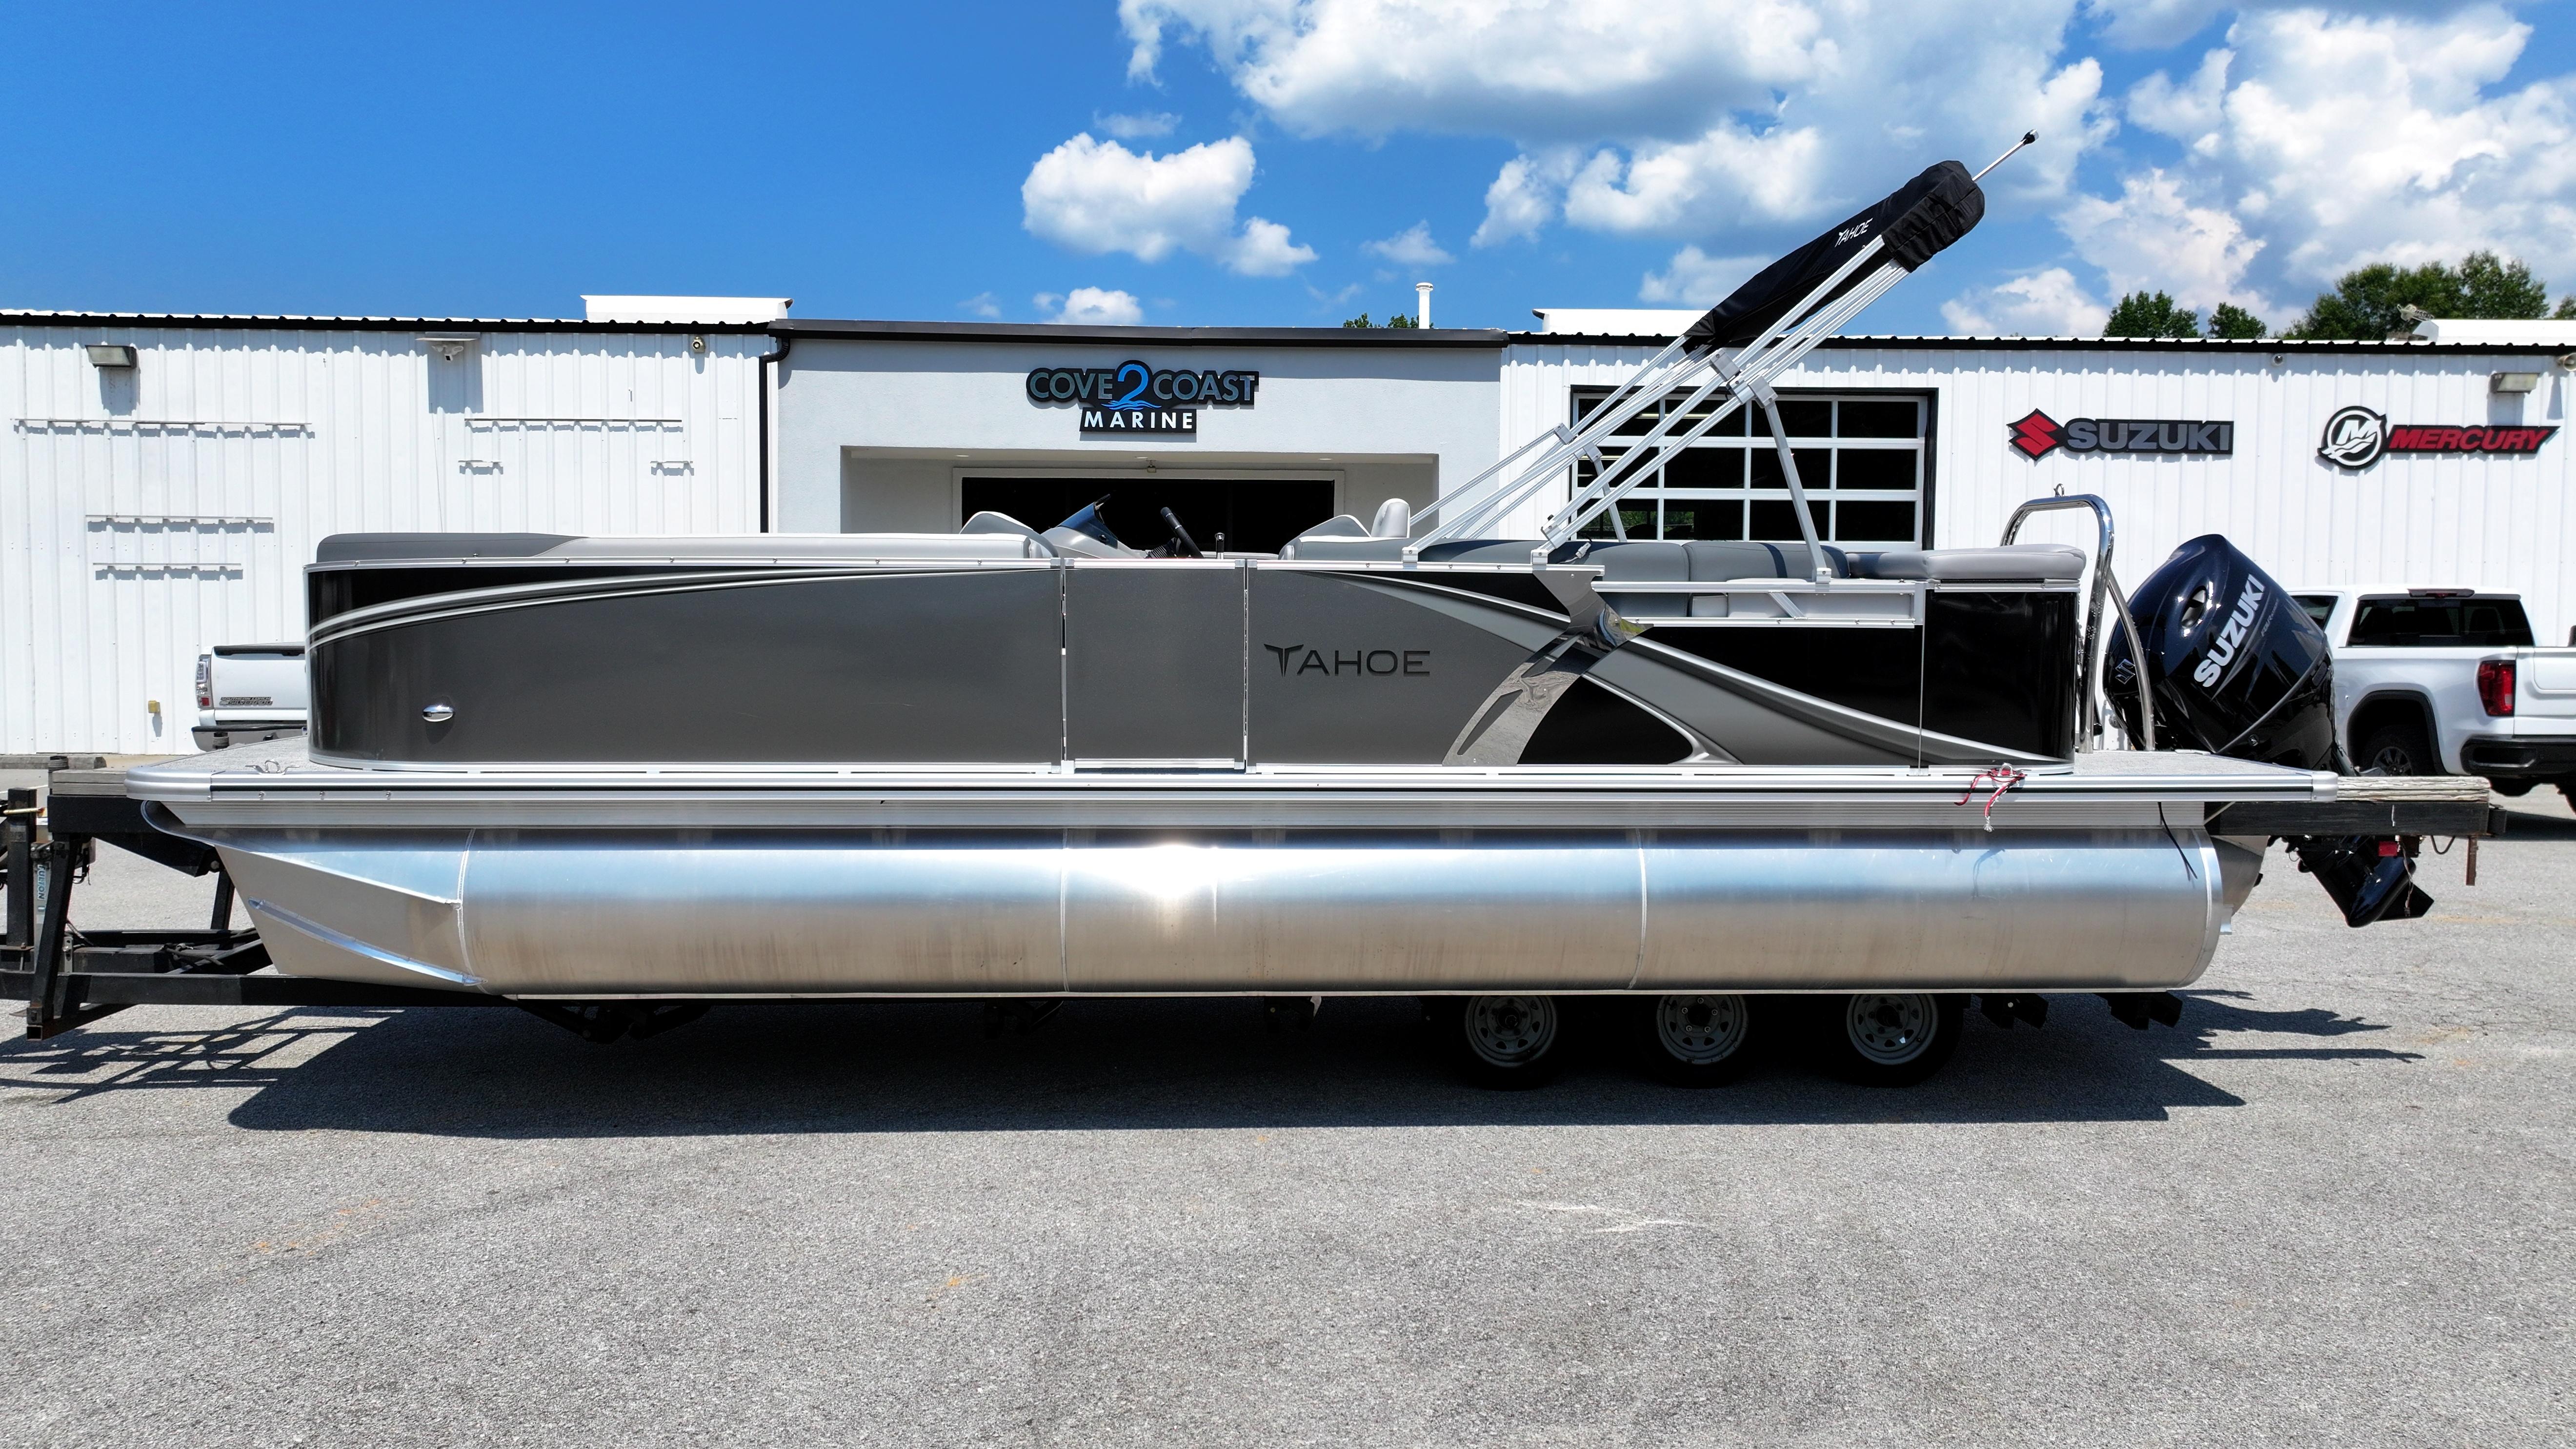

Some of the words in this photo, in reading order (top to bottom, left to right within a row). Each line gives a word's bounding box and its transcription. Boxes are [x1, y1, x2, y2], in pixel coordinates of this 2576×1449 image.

[1834, 218, 1873, 248] TAHOE
[1029, 372, 1113, 399] COVE
[1117, 363, 1149, 404] 2
[1152, 374, 1255, 401] COAST
[1084, 411, 1193, 429] MARINE
[2067, 422, 2233, 451] SUZUKI
[2389, 428, 2550, 450] MERCURY
[2194, 573, 2265, 687] SUZUKI
[1264, 644, 1430, 677] TAHOE
[37, 864, 46, 900] FULTON
